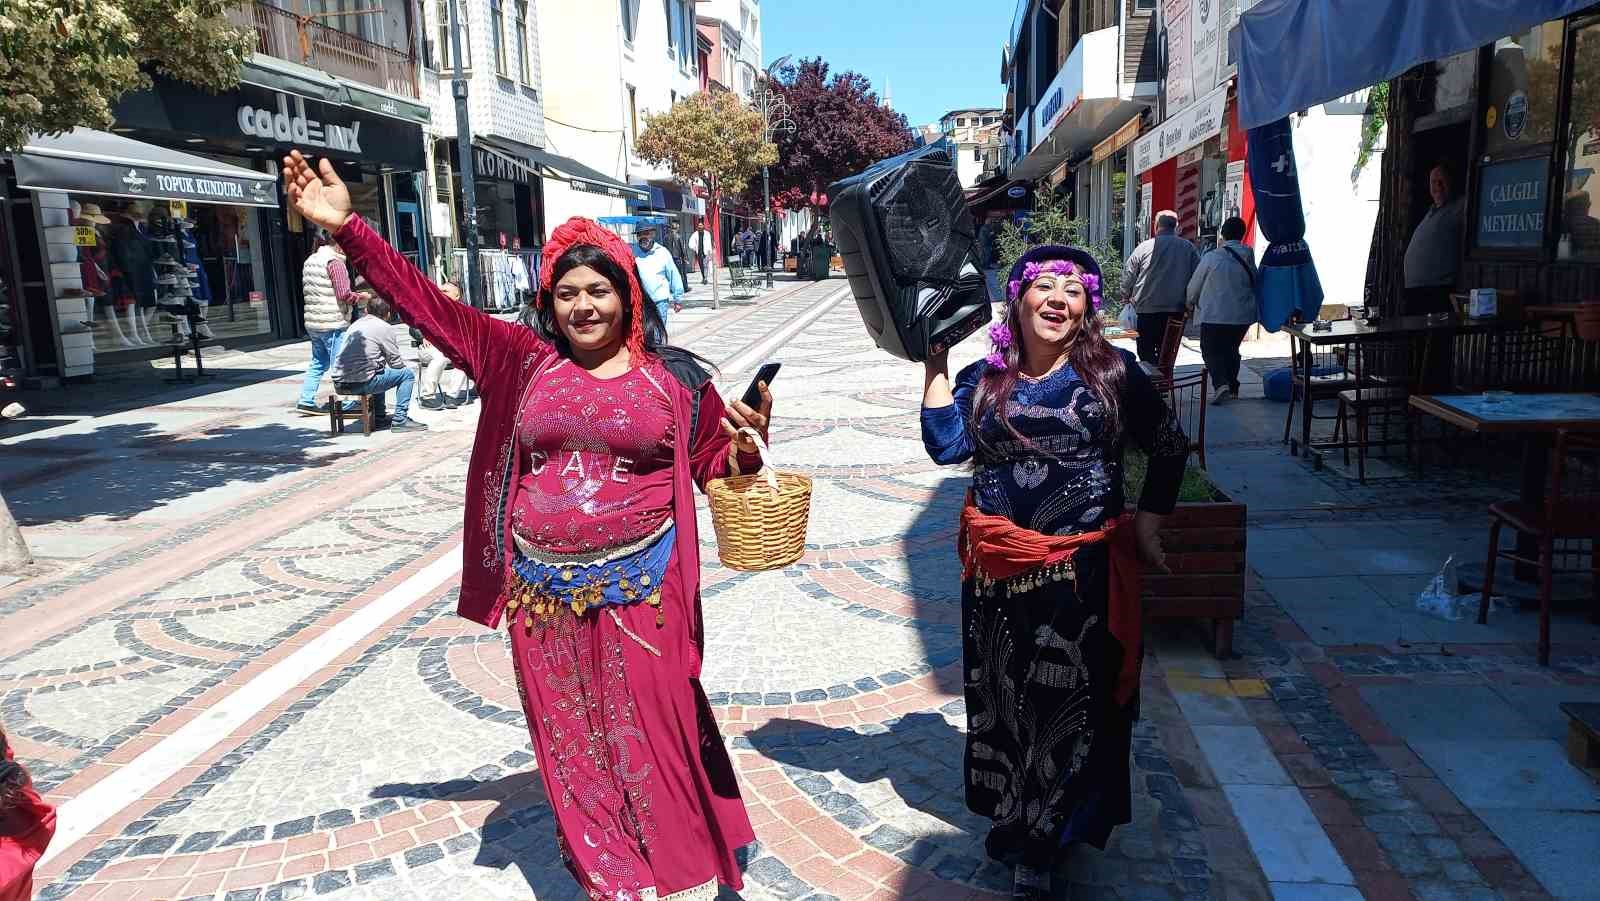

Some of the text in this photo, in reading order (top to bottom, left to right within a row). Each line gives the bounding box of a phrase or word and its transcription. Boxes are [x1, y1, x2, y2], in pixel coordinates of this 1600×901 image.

[156, 174, 195, 194] TOPUK
[195, 178, 244, 198] KUNDURA
[1482, 212, 1545, 233] MEYHANE
